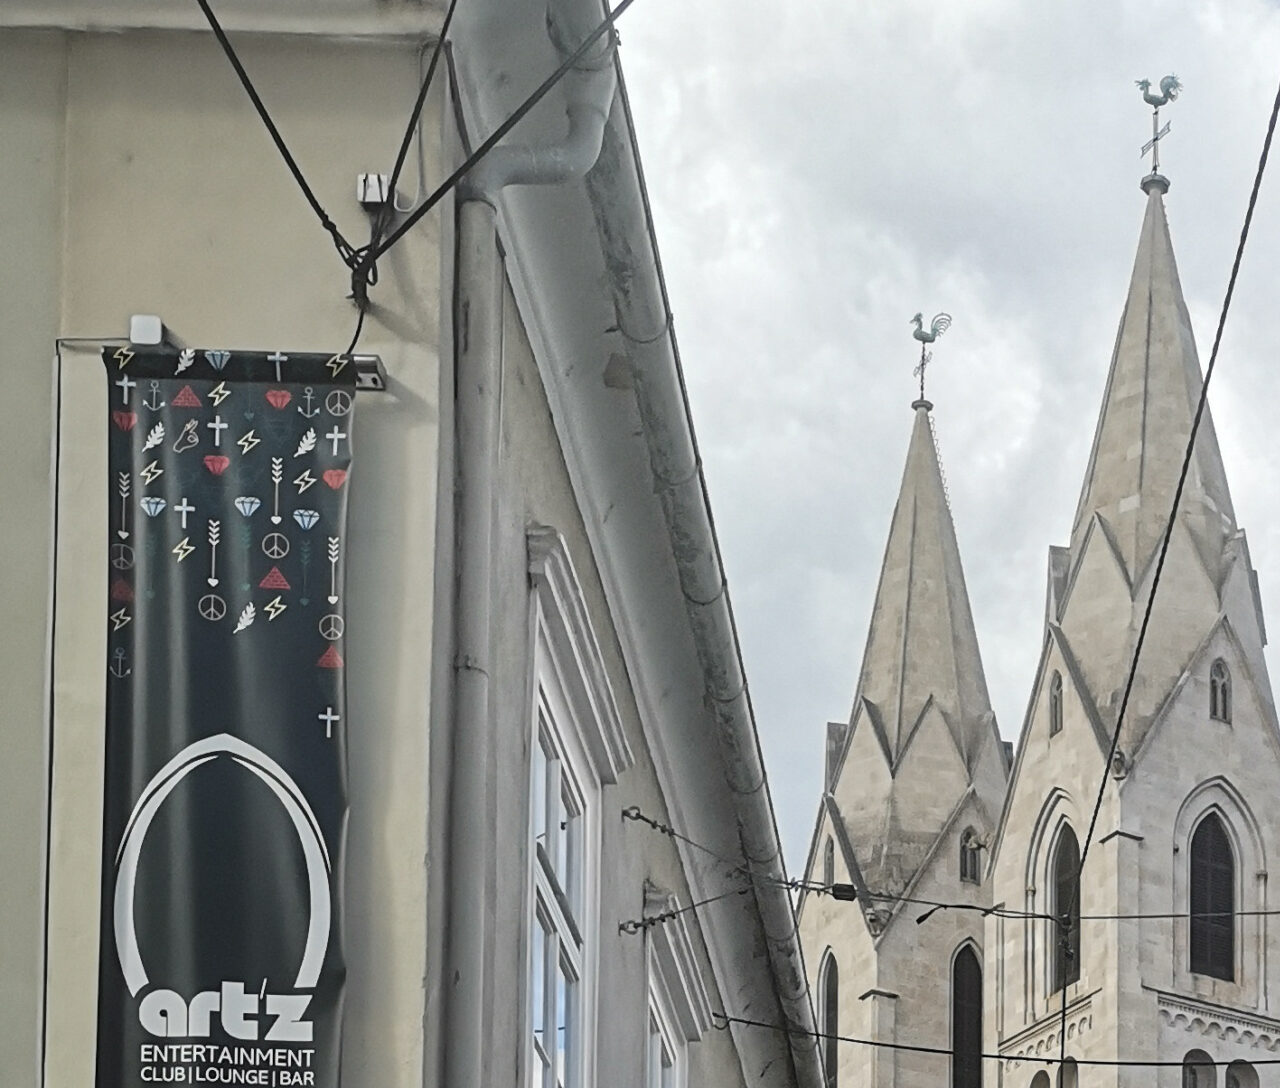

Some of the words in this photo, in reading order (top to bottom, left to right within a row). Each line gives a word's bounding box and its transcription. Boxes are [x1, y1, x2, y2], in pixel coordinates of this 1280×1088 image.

[140, 1045, 315, 1067] ENTERTAINMENT
[140, 1067, 186, 1082] CLUB
[196, 1067, 269, 1084] LOUNGE
[279, 1072, 315, 1086] BAR
